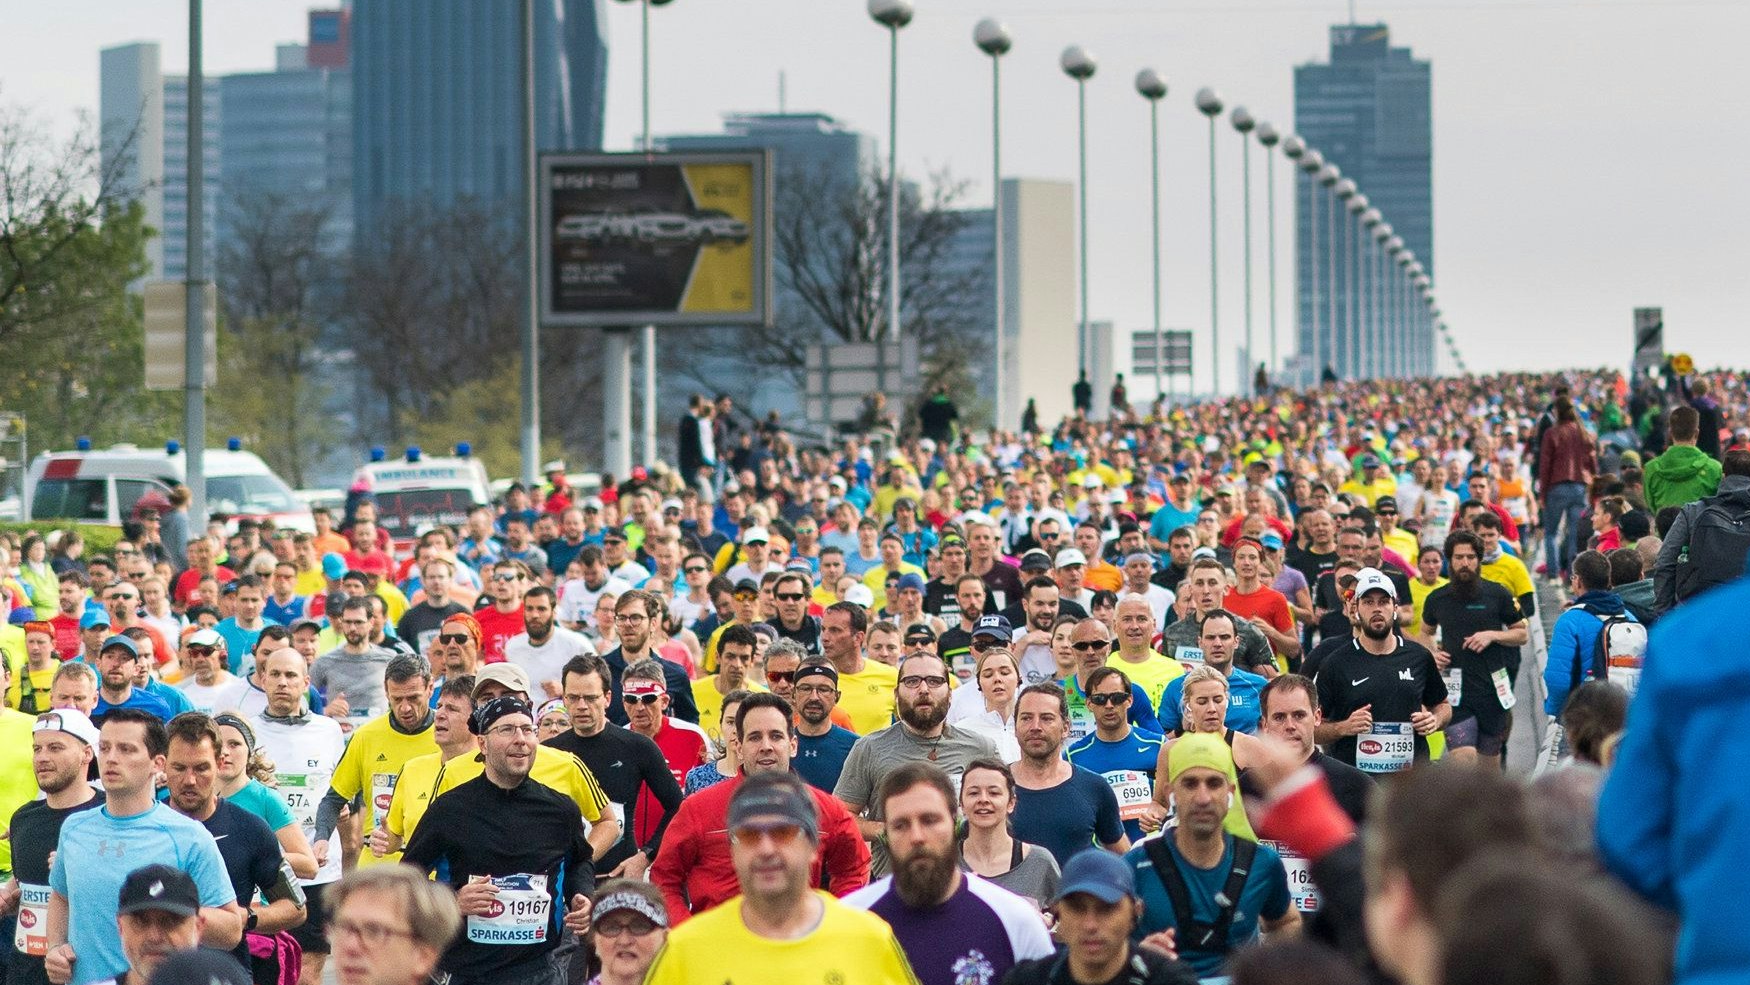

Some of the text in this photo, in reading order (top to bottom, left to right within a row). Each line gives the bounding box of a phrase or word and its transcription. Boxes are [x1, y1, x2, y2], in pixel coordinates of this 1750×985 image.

[1183, 650, 1203, 660] ERST
[1384, 741, 1413, 753] 21593
[307, 759, 319, 768] EY
[1358, 761, 1402, 771] SPARKASSE
[1122, 786, 1150, 799] 6905
[23, 888, 51, 903] ERSTE
[508, 899, 550, 916] 19167
[515, 917, 540, 925] Christian
[471, 928, 535, 941] SPARKASSE
